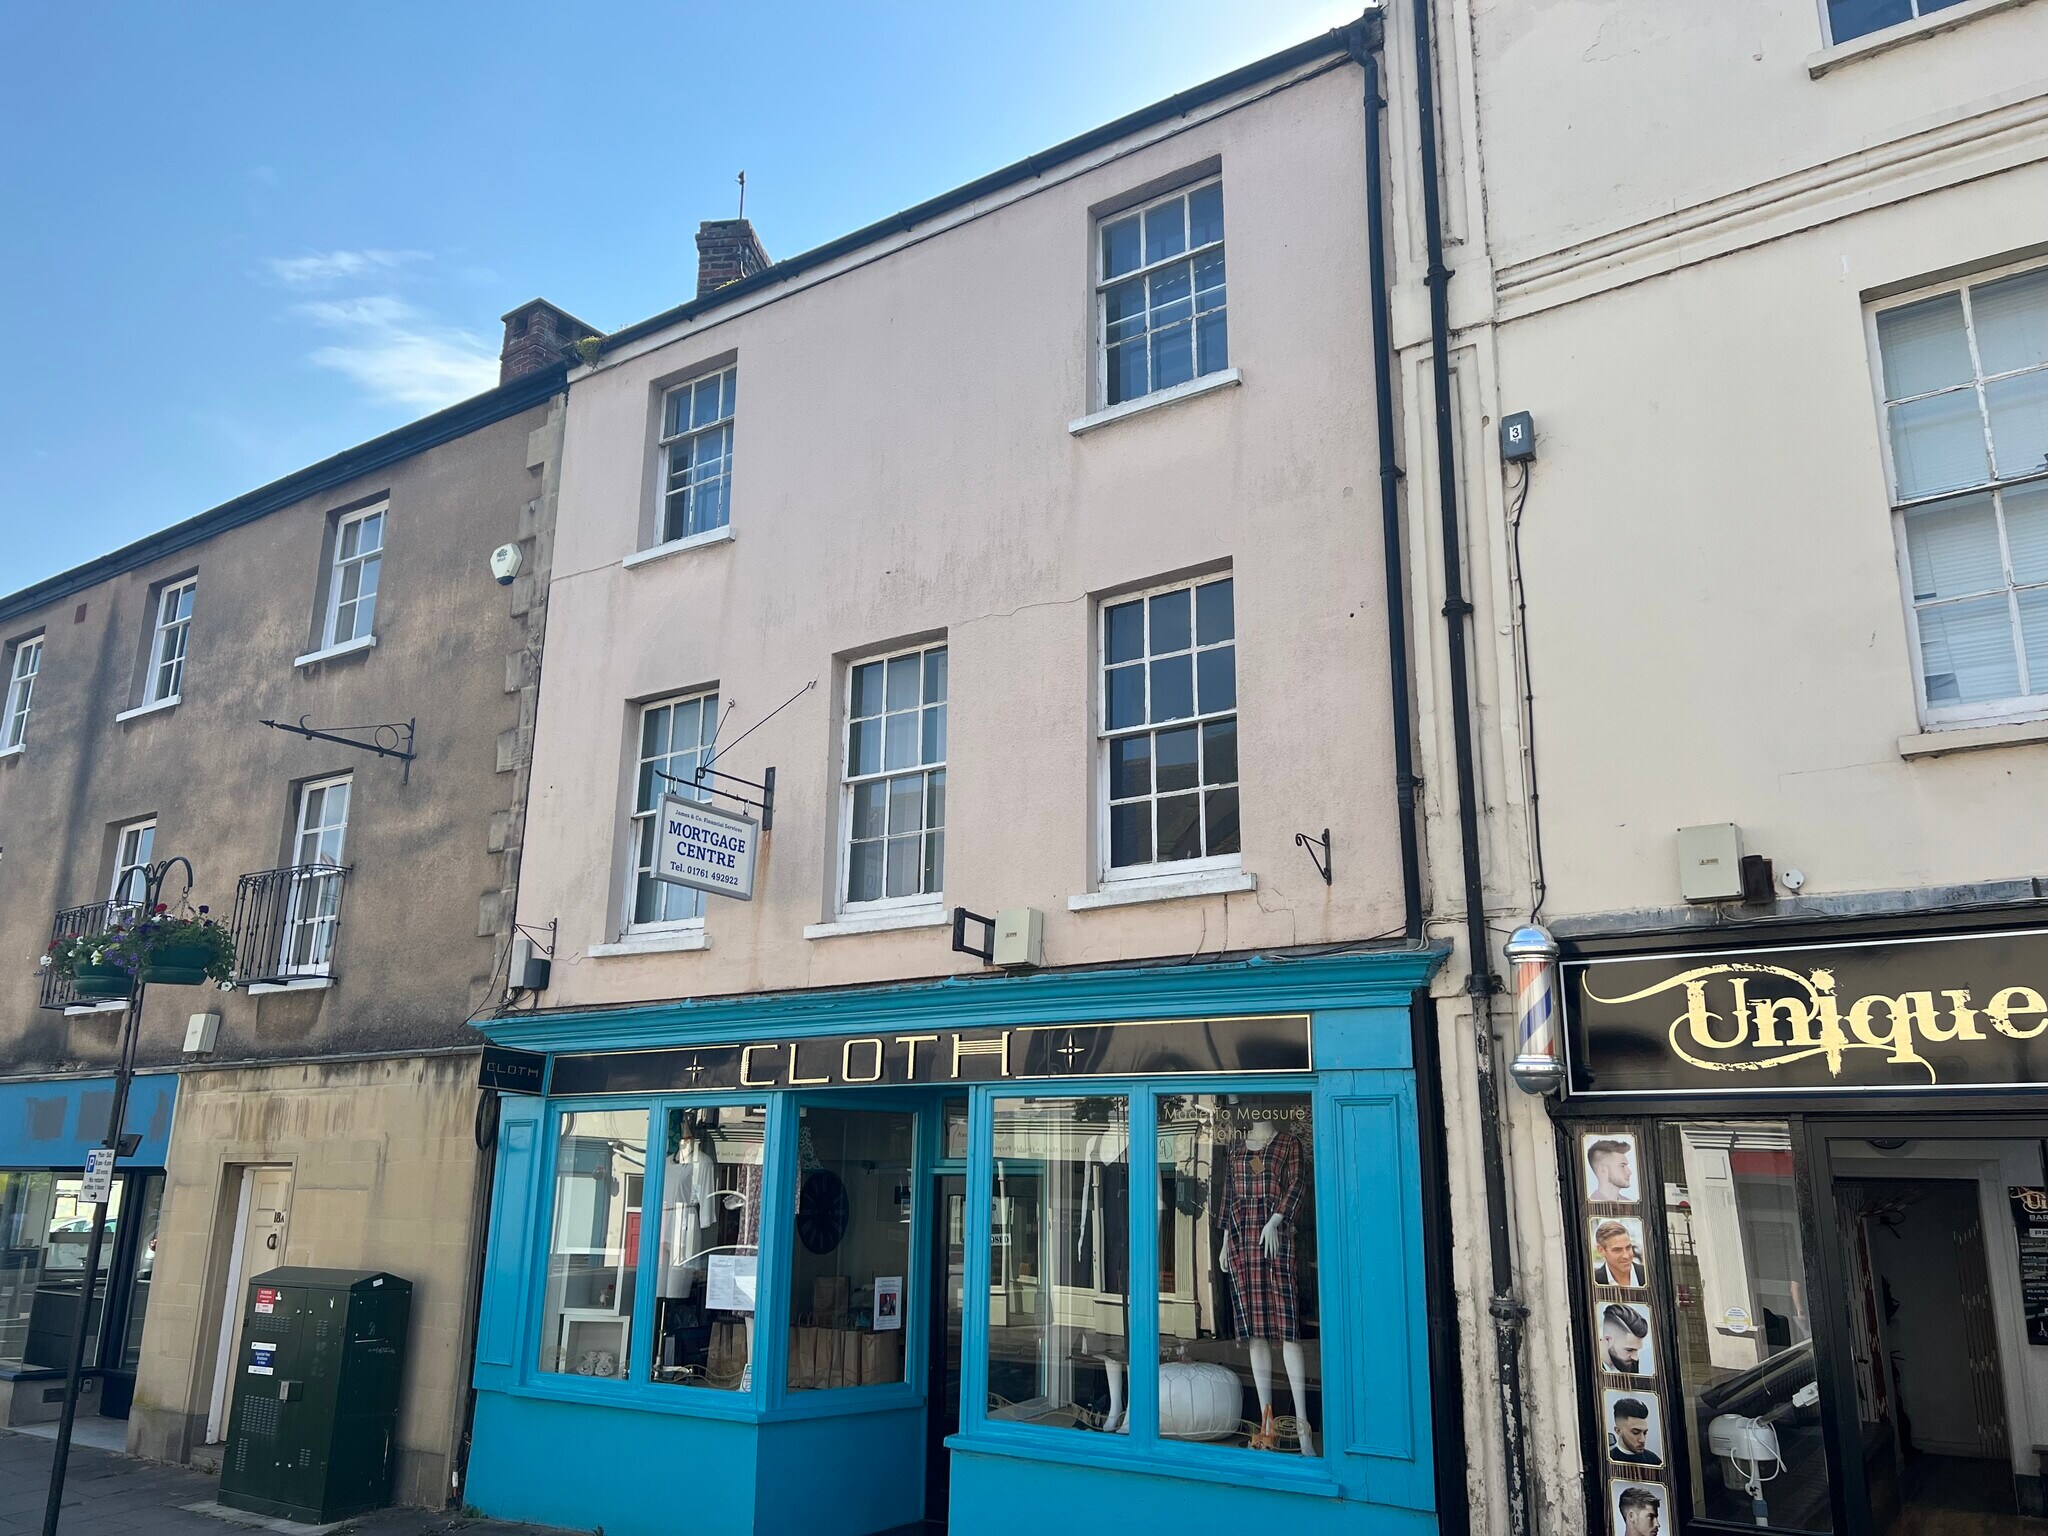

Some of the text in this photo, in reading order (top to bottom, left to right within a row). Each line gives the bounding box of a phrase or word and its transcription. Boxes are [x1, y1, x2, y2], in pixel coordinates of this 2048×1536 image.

[1512, 427, 1519, 438] 3
[675, 810, 690, 819] James
[703, 817, 724, 828] Financial
[724, 823, 743, 833] Services
[668, 820, 746, 853] MORTGAGE
[676, 841, 736, 869] CENTRE
[670, 861, 739, 886] Tel. 01761 492922
[1668, 964, 2048, 1084] Unique
[486, 1062, 540, 1078] CLOTH
[740, 1031, 1011, 1086] CLOTH
[1164, 1107, 1305, 1120] Made To Measure
[88, 1157, 95, 1171] P
